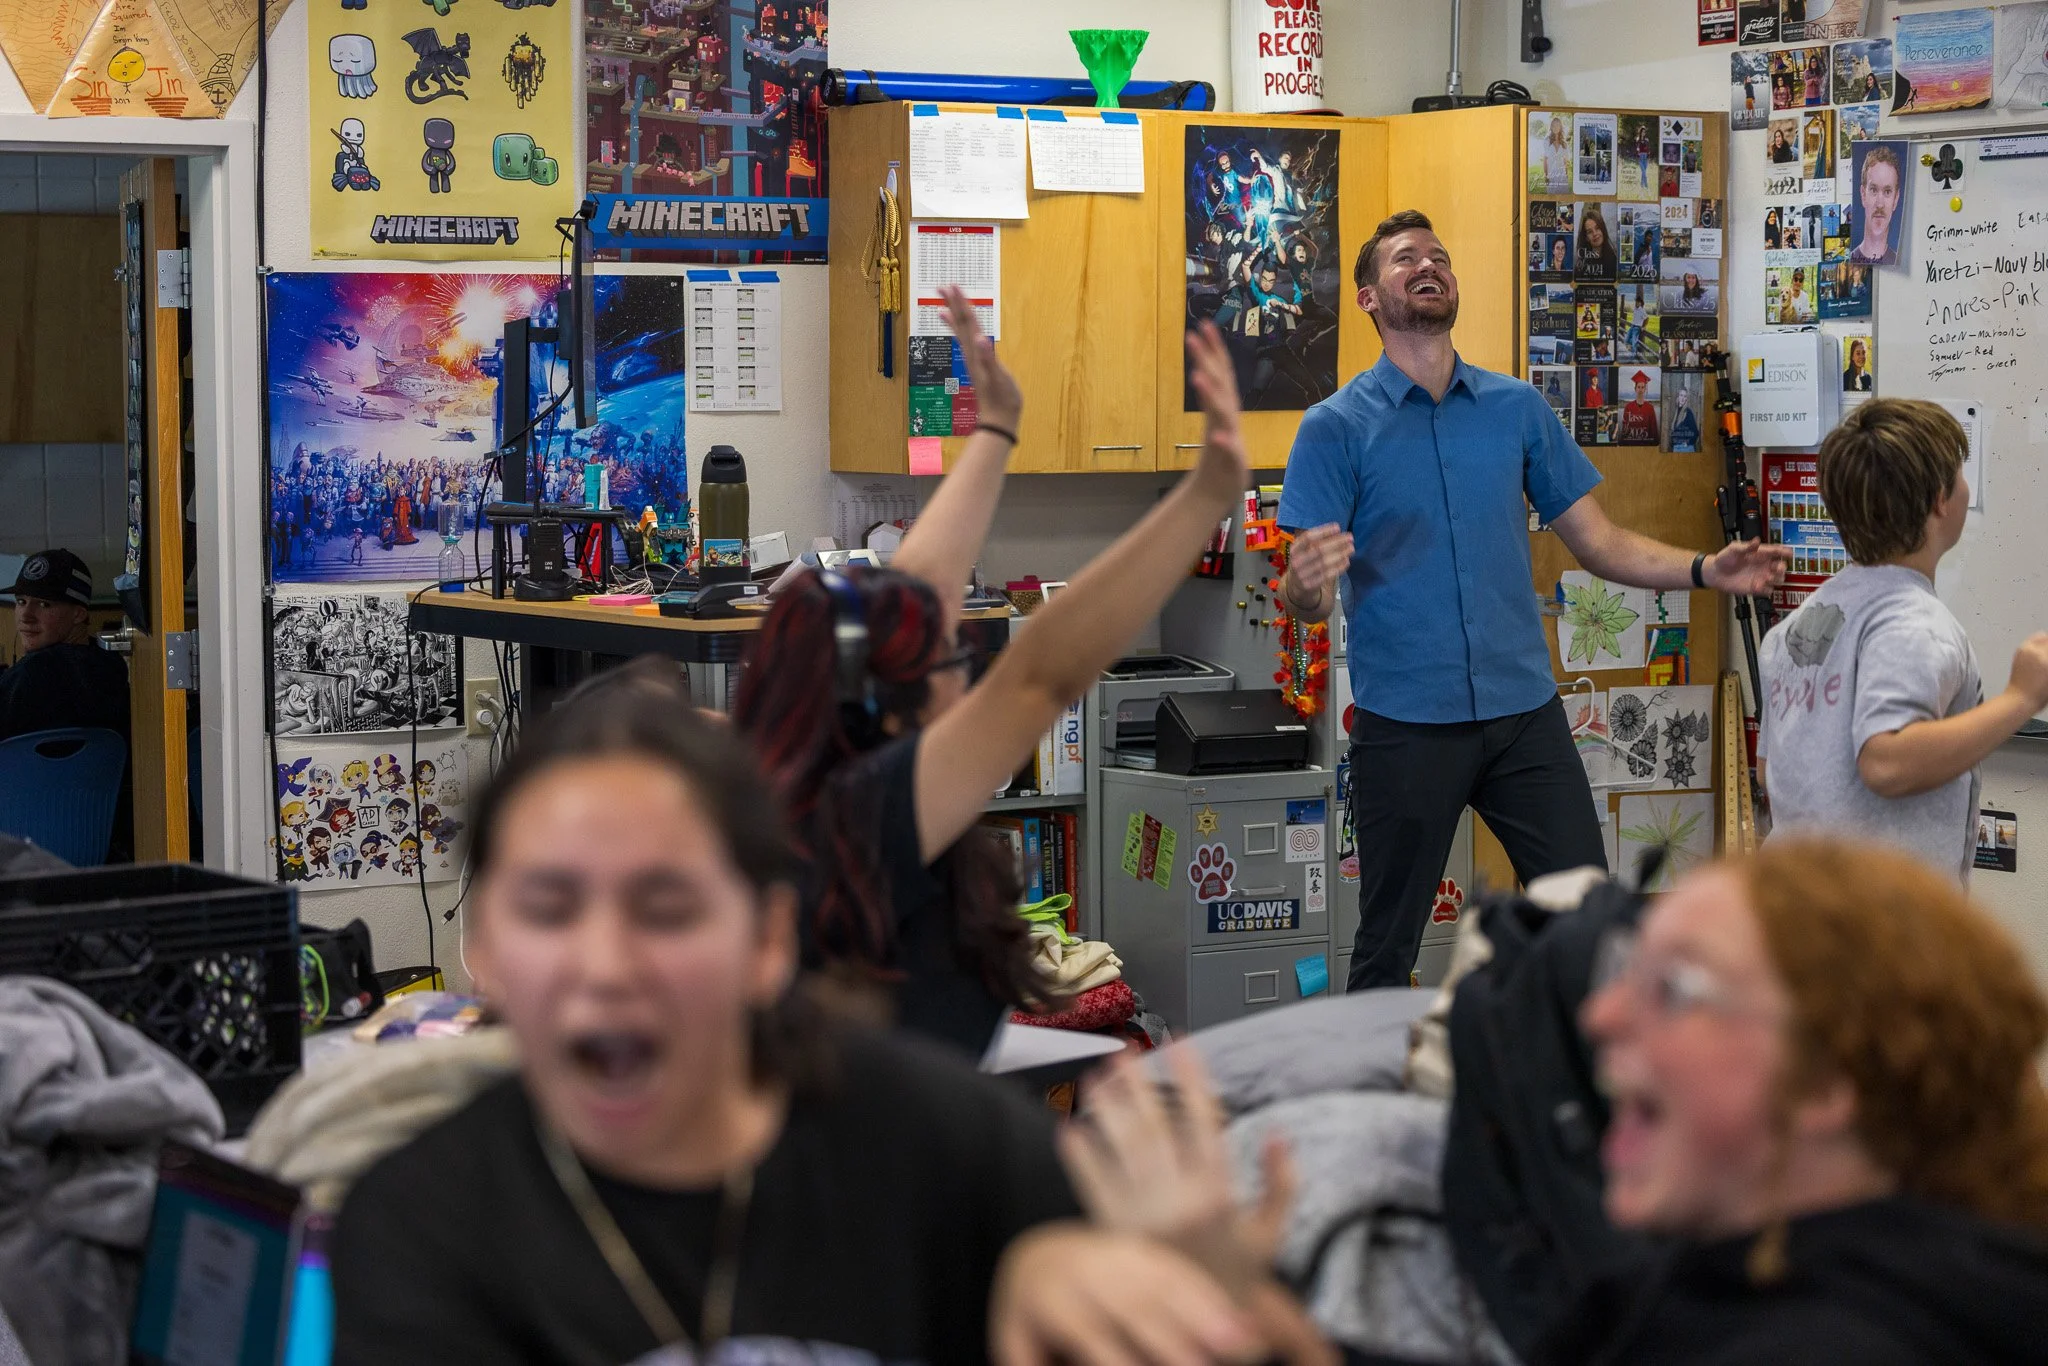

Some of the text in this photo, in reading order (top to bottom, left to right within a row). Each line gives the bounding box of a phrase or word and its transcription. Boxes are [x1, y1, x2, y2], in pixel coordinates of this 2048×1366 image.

[1274, 10, 1322, 31] PLEASE
[1741, 16, 1778, 40] graduate
[1904, 44, 1983, 61] Perseverance
[1297, 57, 1312, 72] IN
[73, 66, 111, 98] Sin
[146, 67, 186, 97] Jin
[1733, 108, 1765, 120] GRADUATE
[607, 200, 810, 240] MINECRAFT
[1665, 206, 1688, 219] 2024
[370, 215, 519, 245] MINECRAFT
[1577, 247, 1600, 259] Class
[1631, 264, 1657, 278] 2025
[1768, 369, 1807, 383] EDISON
[1623, 411, 1644, 423] Class
[1750, 412, 1807, 422] FIRST AID KIT
[1064, 720, 1083, 764] ngpf
[1218, 918, 1291, 931] GRADUATE
